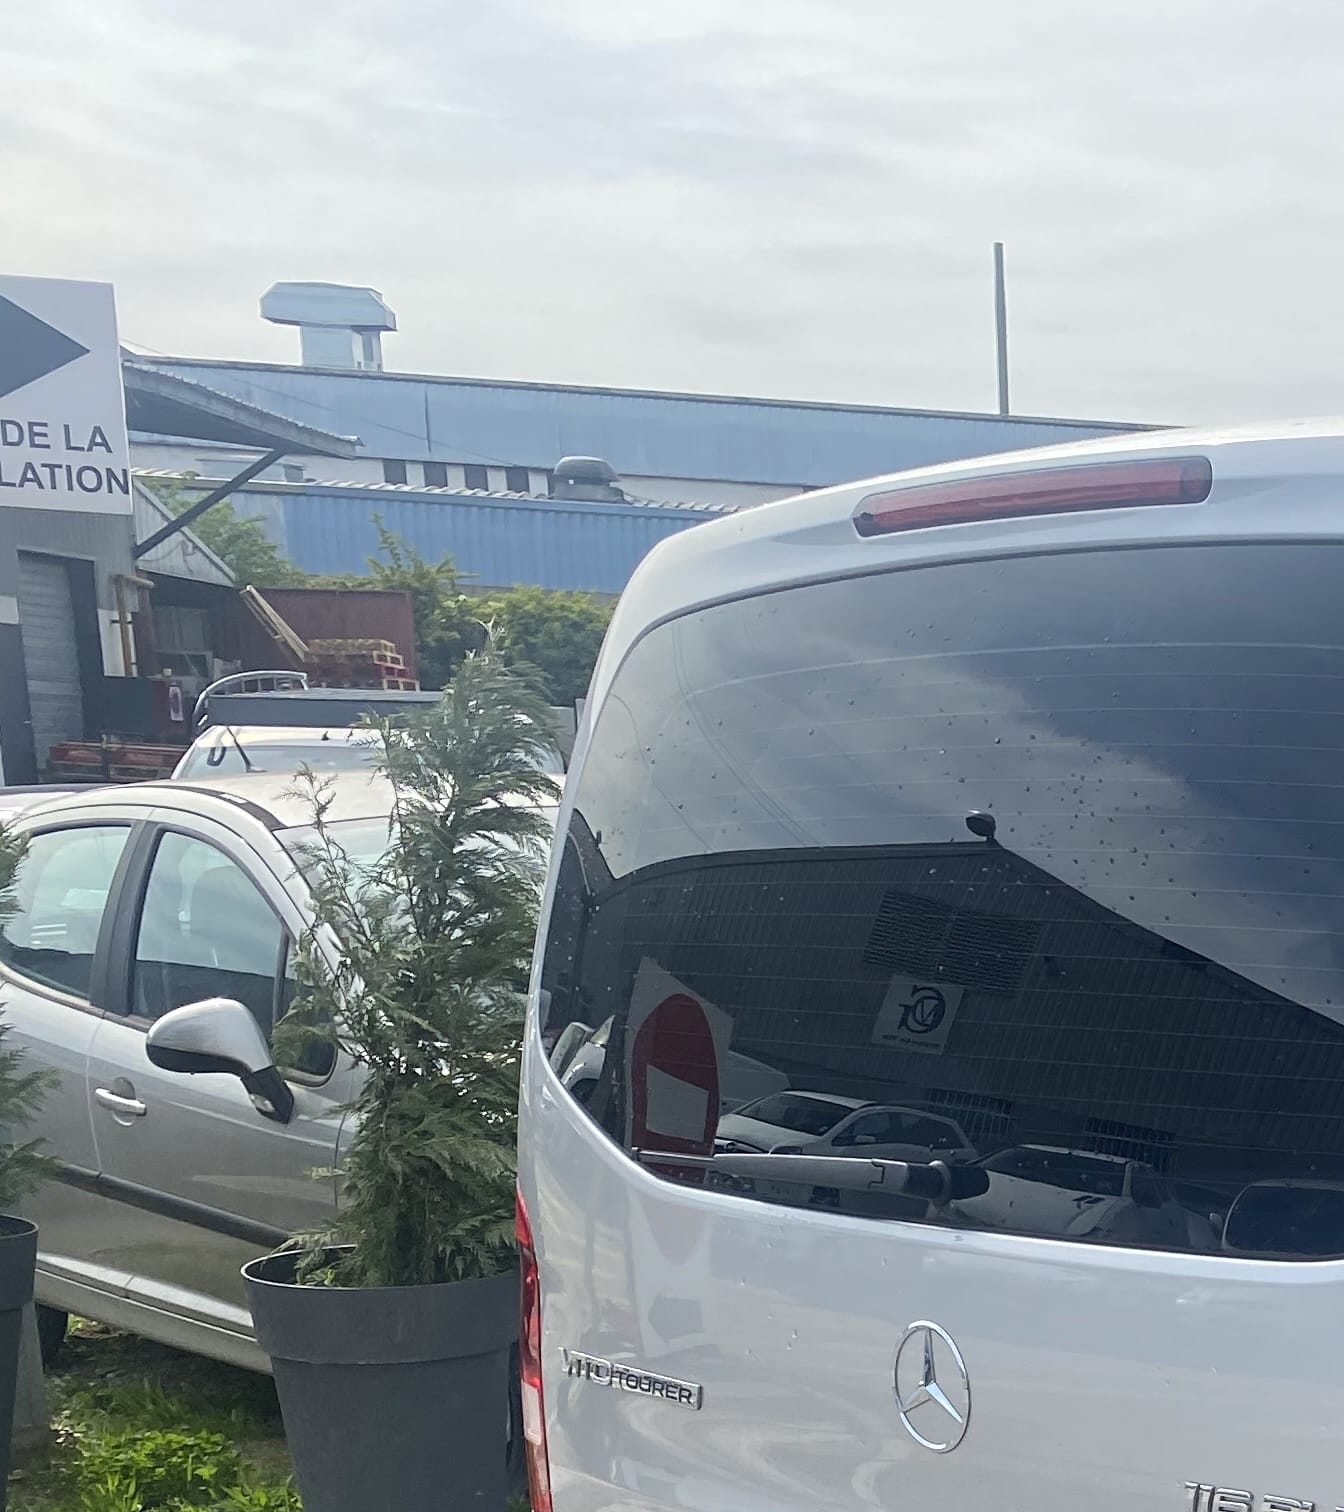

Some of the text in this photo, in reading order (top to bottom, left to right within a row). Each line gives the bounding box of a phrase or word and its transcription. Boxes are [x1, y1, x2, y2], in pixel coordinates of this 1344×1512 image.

[0, 419, 113, 454] DE LA
[0, 461, 130, 496] LATION
[558, 1346, 694, 1405] VITO TOURER
